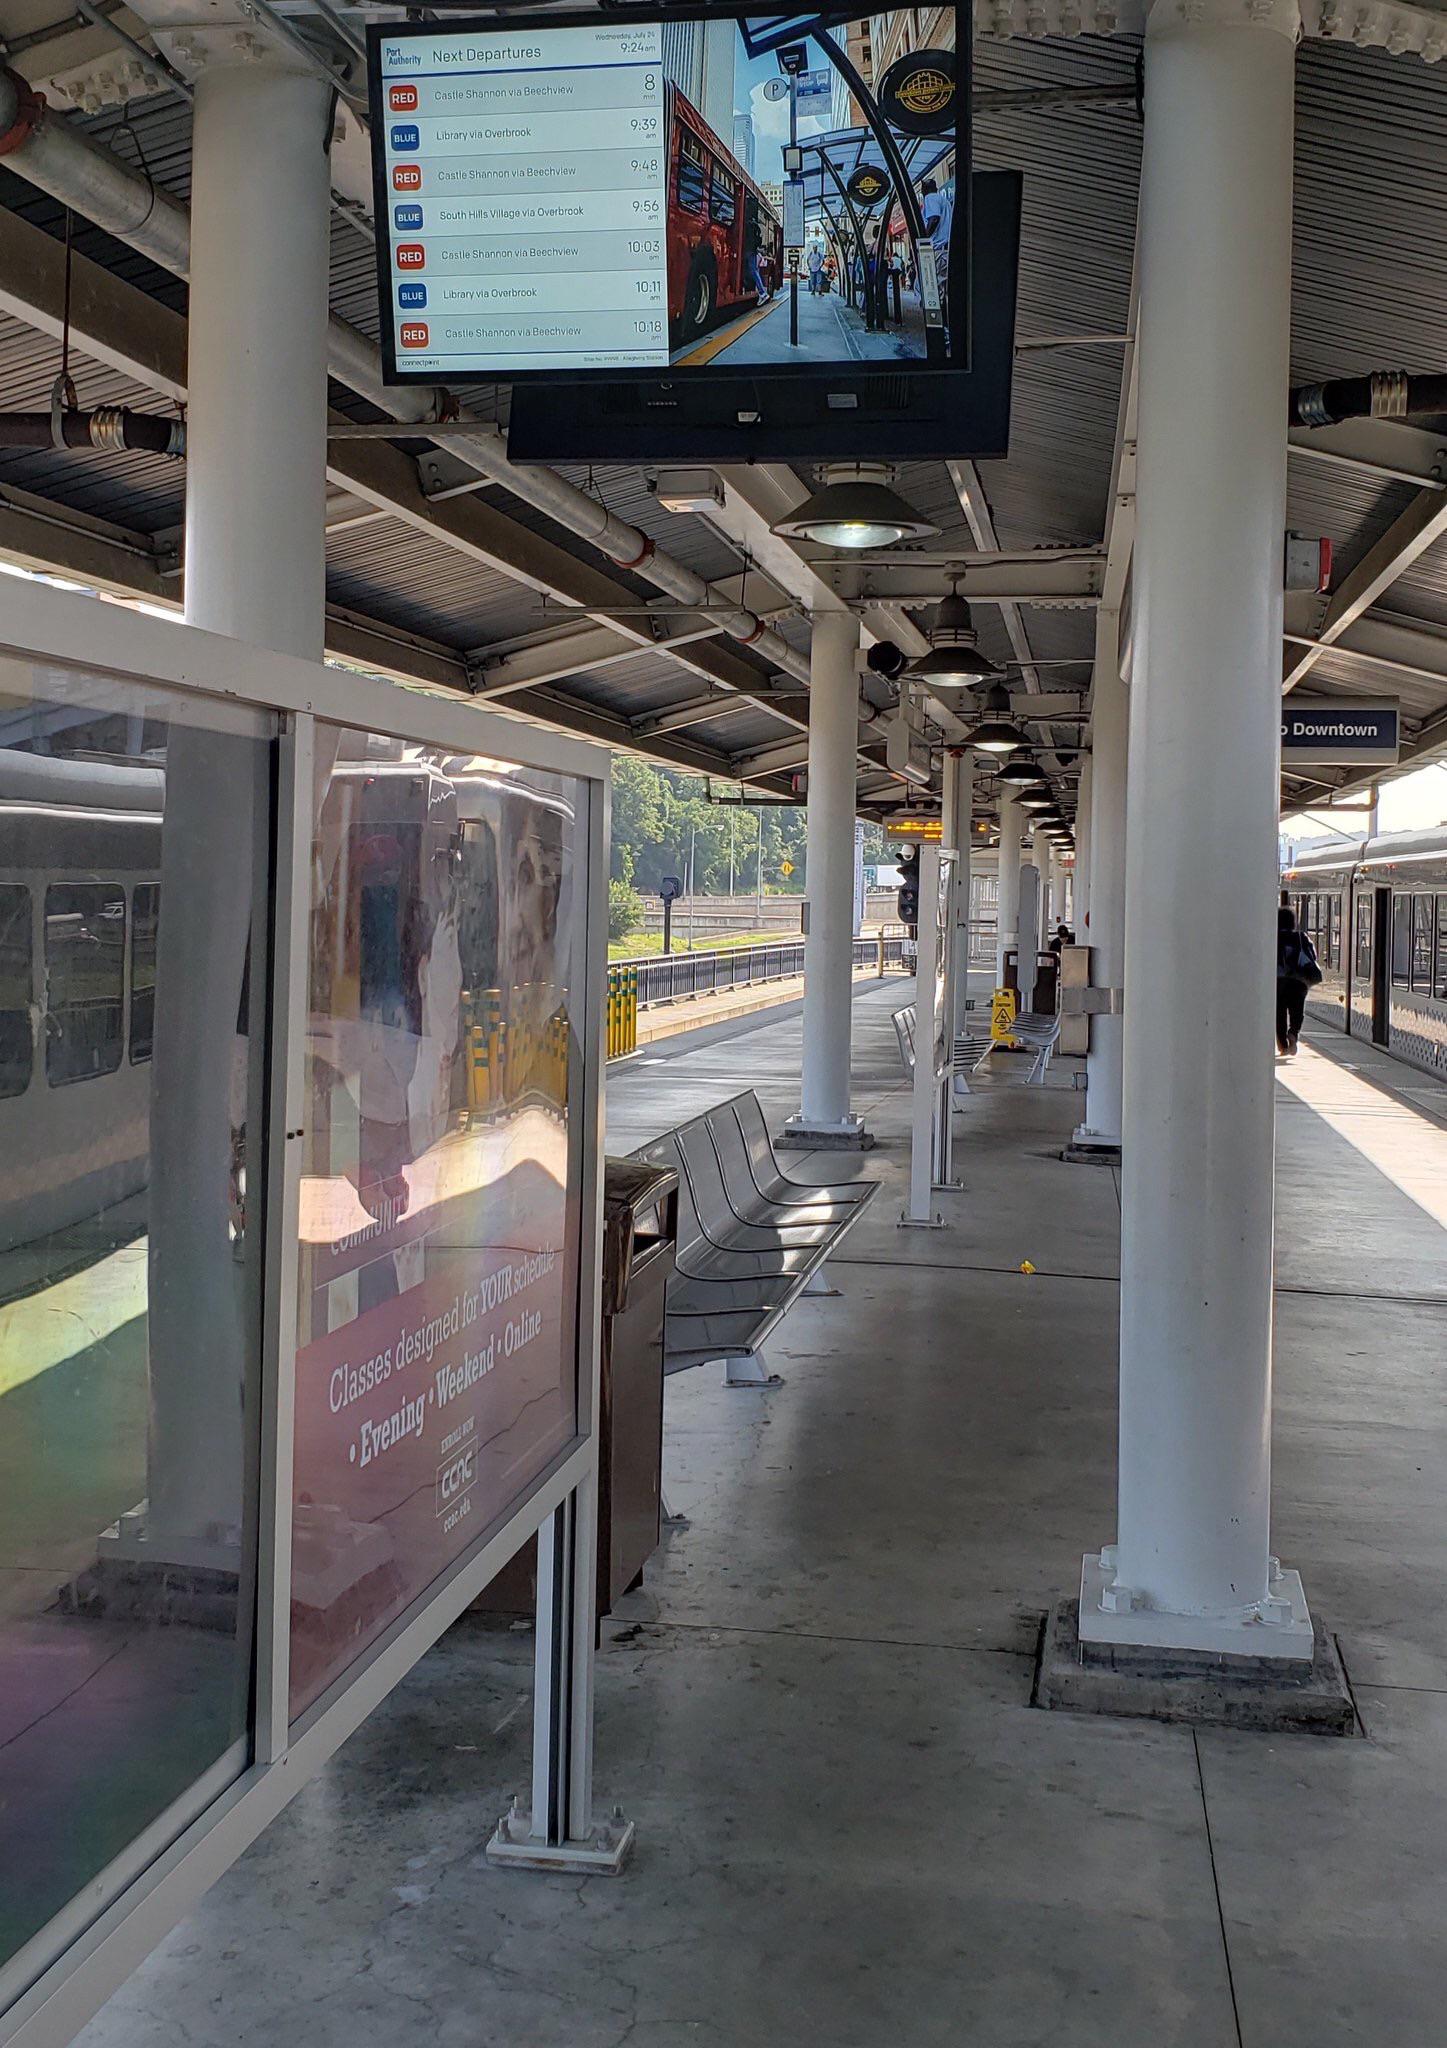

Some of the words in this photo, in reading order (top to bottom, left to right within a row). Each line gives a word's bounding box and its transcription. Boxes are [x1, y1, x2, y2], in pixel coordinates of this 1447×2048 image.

[386, 48, 401, 57] Port
[620, 42, 643, 52] 9:24
[388, 54, 421, 66] Authority
[432, 49, 463, 63] Next
[467, 47, 541, 61] Departures
[644, 73, 655, 91] 8
[392, 92, 415, 104] RED
[435, 89, 463, 101] Castle
[466, 88, 507, 99] Shannon
[509, 88, 522, 98] via
[524, 85, 574, 96] Beechview
[630, 119, 657, 132] 9:39
[394, 133, 416, 143] BLUE
[436, 129, 468, 142] Library
[470, 130, 483, 140] via
[485, 127, 531, 139] Overbrook
[631, 160, 658, 172] 9:48
[395, 172, 419, 184] RED
[438, 169, 467, 181] Castle
[470, 168, 510, 179] Shannon
[512, 168, 524, 178] via
[527, 165, 576, 177] Beechview
[632, 201, 659, 212] 9:56
[398, 213, 420, 222] BLUE
[440, 210, 467, 220] South
[469, 208, 488, 219] Hills
[491, 208, 520, 220] Village
[522, 208, 535, 217] via
[537, 206, 584, 217] Overbrook
[628, 240, 660, 253] 10:03
[400, 252, 422, 262] RED
[442, 249, 470, 260] Castle
[473, 248, 513, 259] Shannon
[515, 248, 528, 258] via
[530, 246, 579, 257] Beechview
[636, 281, 661, 293] 10:11
[401, 291, 424, 301] BLUE
[443, 289, 475, 301] Library
[477, 289, 489, 299] via
[491, 287, 537, 298] Overbrook
[445, 328, 473, 339] Castle
[476, 327, 516, 338] Shannon
[518, 326, 531, 336] via
[533, 325, 582, 336] Beechview
[634, 321, 662, 333] 10:18
[403, 330, 426, 341] RED
[1293, 722, 1378, 736] Downtown
[330, 1349, 392, 1413] Classes
[396, 1296, 459, 1371] designed
[461, 1290, 480, 1329] for
[480, 1264, 514, 1316] YOUR
[514, 1242, 555, 1295] schedule
[360, 1392, 425, 1468] Evening
[435, 1334, 495, 1409] Weekend
[504, 1310, 542, 1358] Online
